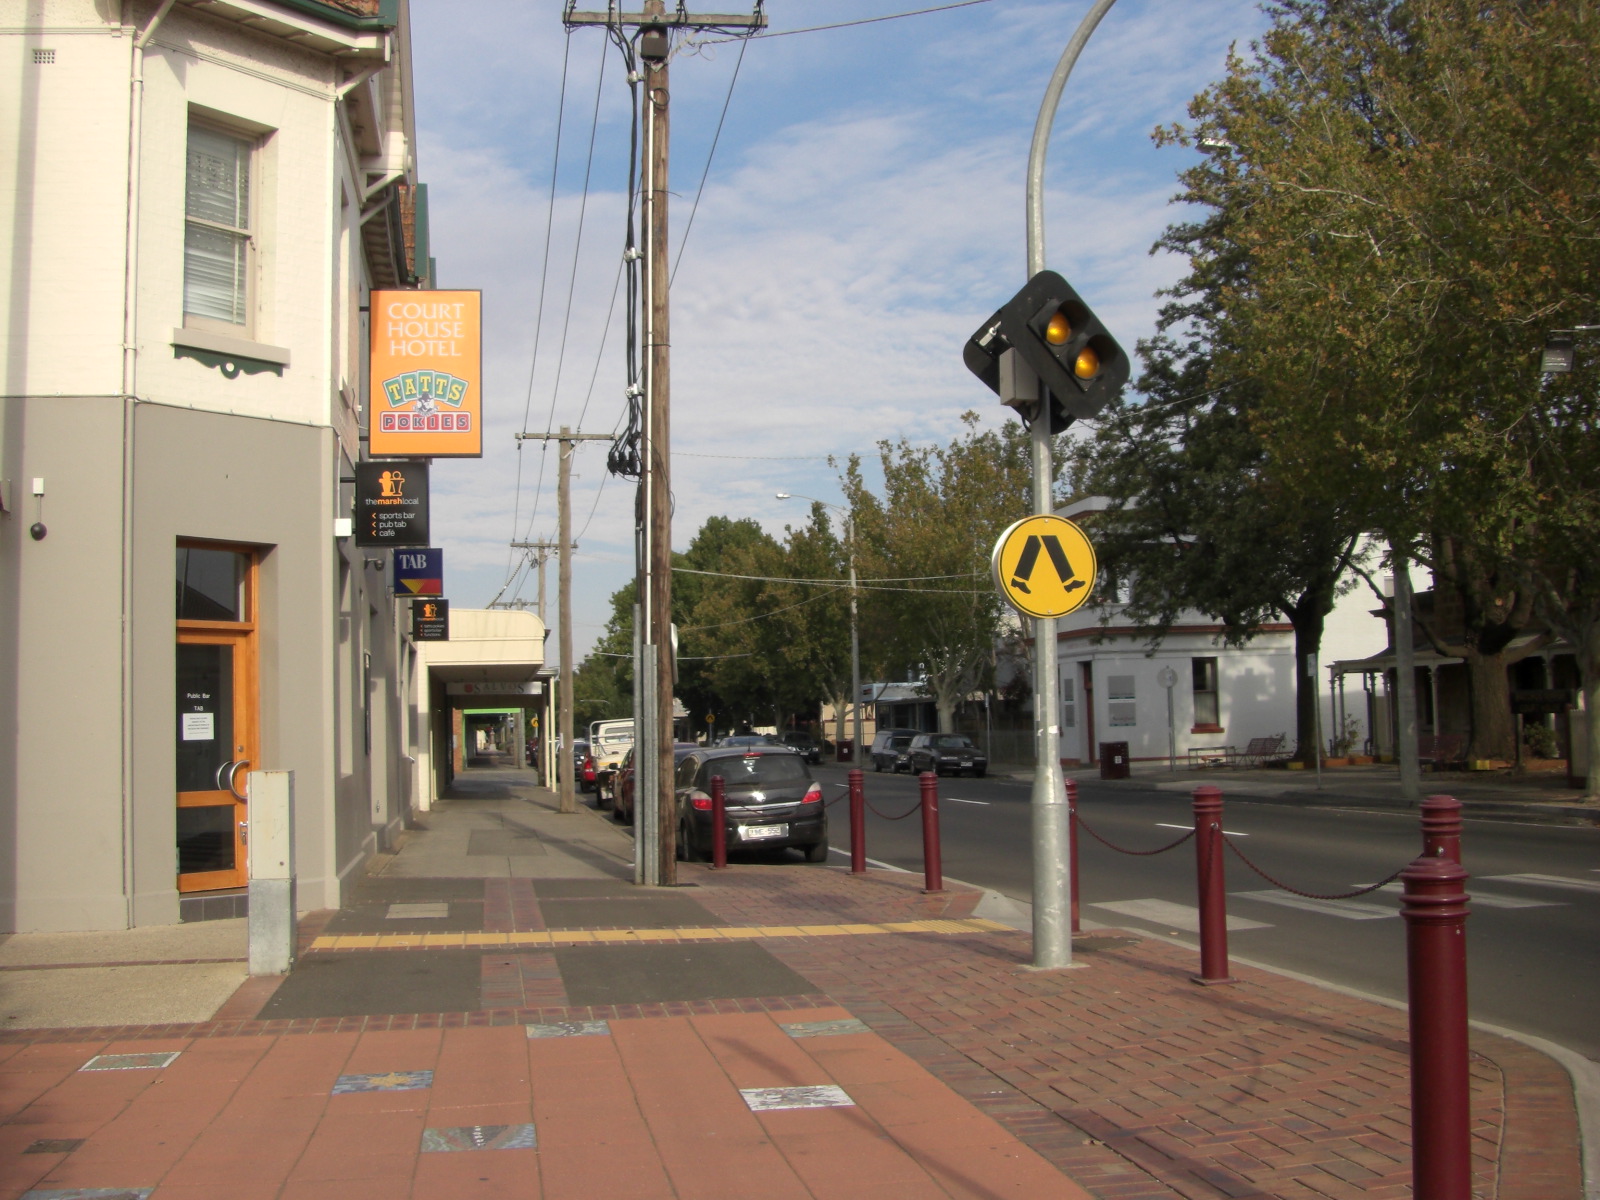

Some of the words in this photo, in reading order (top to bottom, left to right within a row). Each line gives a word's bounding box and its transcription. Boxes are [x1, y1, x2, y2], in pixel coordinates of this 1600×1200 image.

[387, 303, 465, 319] COURT
[387, 321, 465, 338] HOUSE
[389, 340, 462, 356] HOTEL
[388, 376, 463, 401] TATTS
[384, 416, 467, 427] POKIES
[379, 512, 402, 520] sports
[379, 520, 393, 529] pub
[400, 554, 427, 569] TAB
[474, 682, 525, 694] SALVOS
